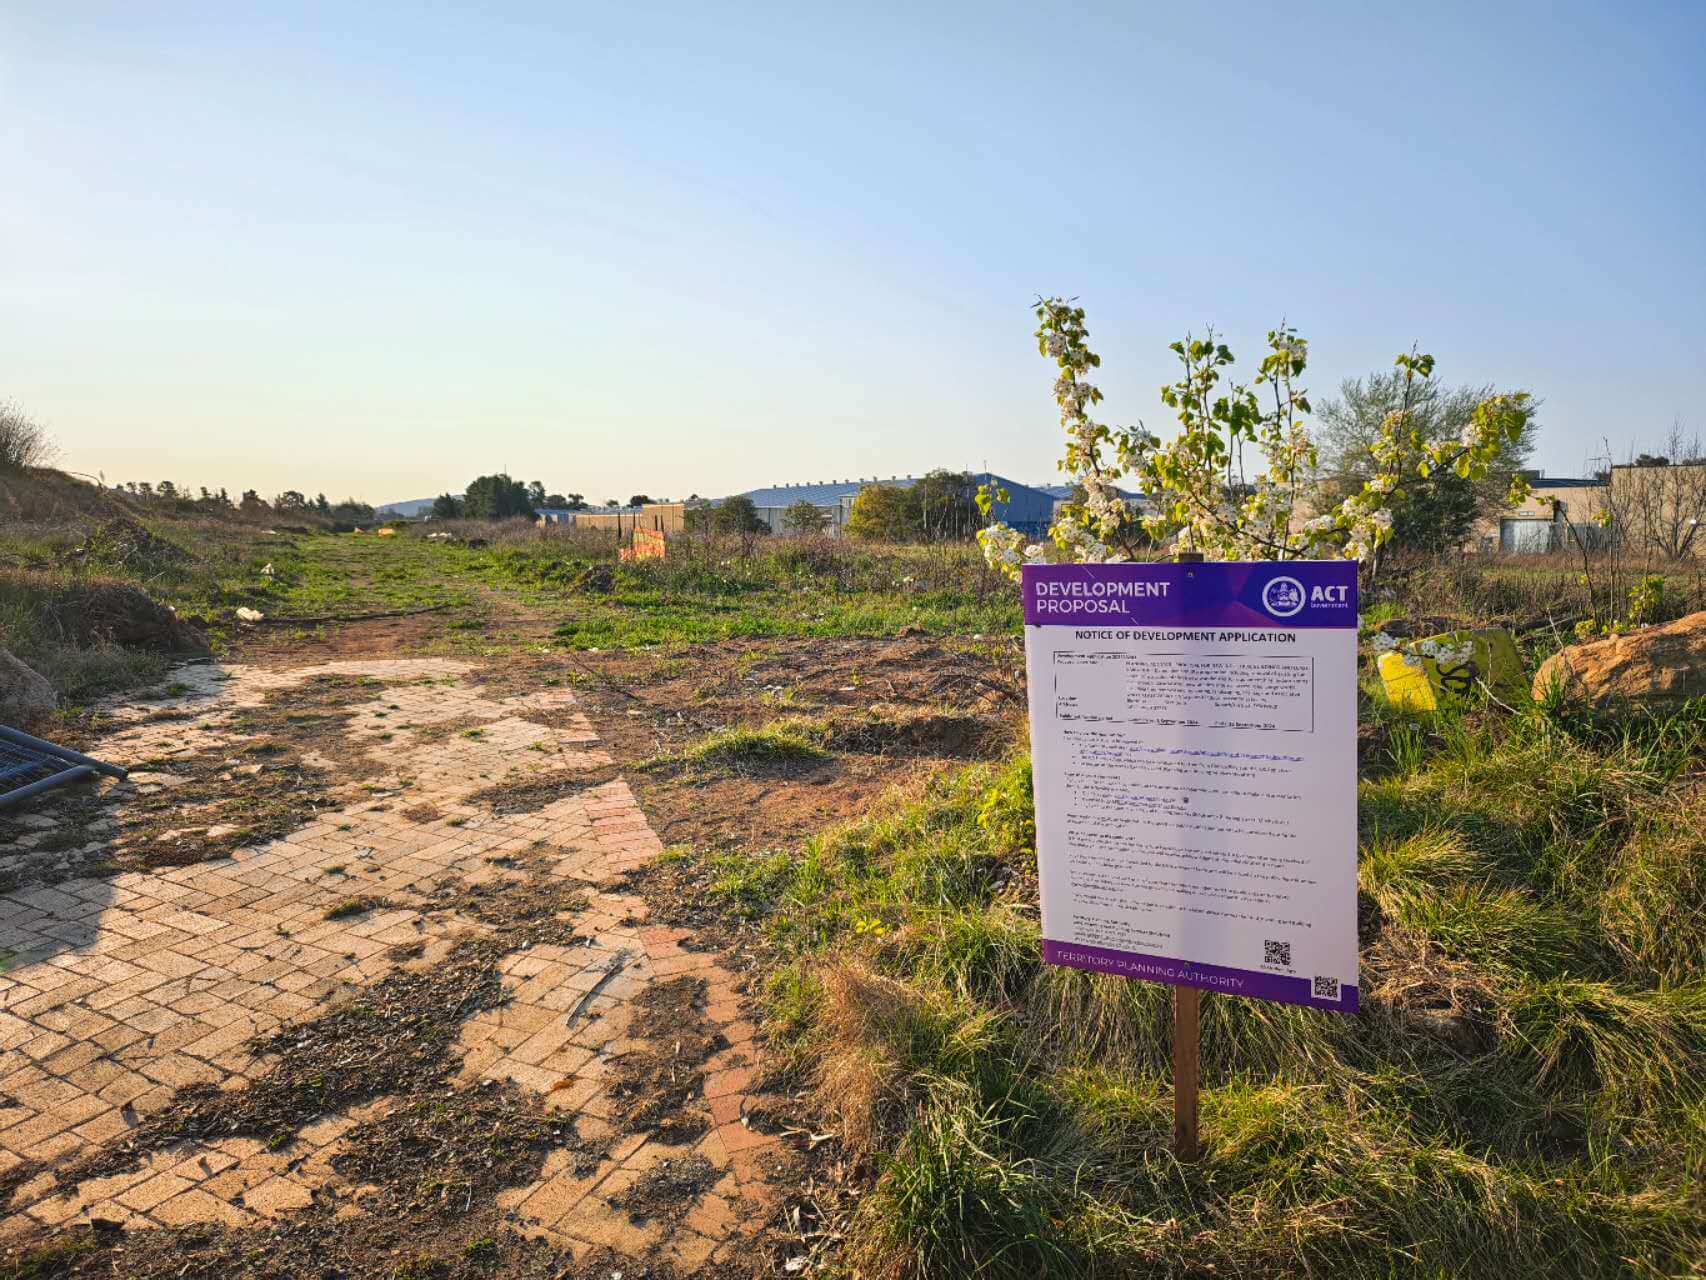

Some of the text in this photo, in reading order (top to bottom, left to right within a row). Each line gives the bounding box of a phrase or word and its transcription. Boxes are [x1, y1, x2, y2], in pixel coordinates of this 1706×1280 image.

[1035, 581, 1171, 598] DEVELOPMENT
[1310, 585, 1349, 602] ACT
[1036, 599, 1130, 614] PROPOSAL
[1075, 630, 1297, 643] NOTICE OF DEVELOPMENT APPLICATION
[1057, 950, 1245, 989] TERRITORY PLANNING AUTHORITY
